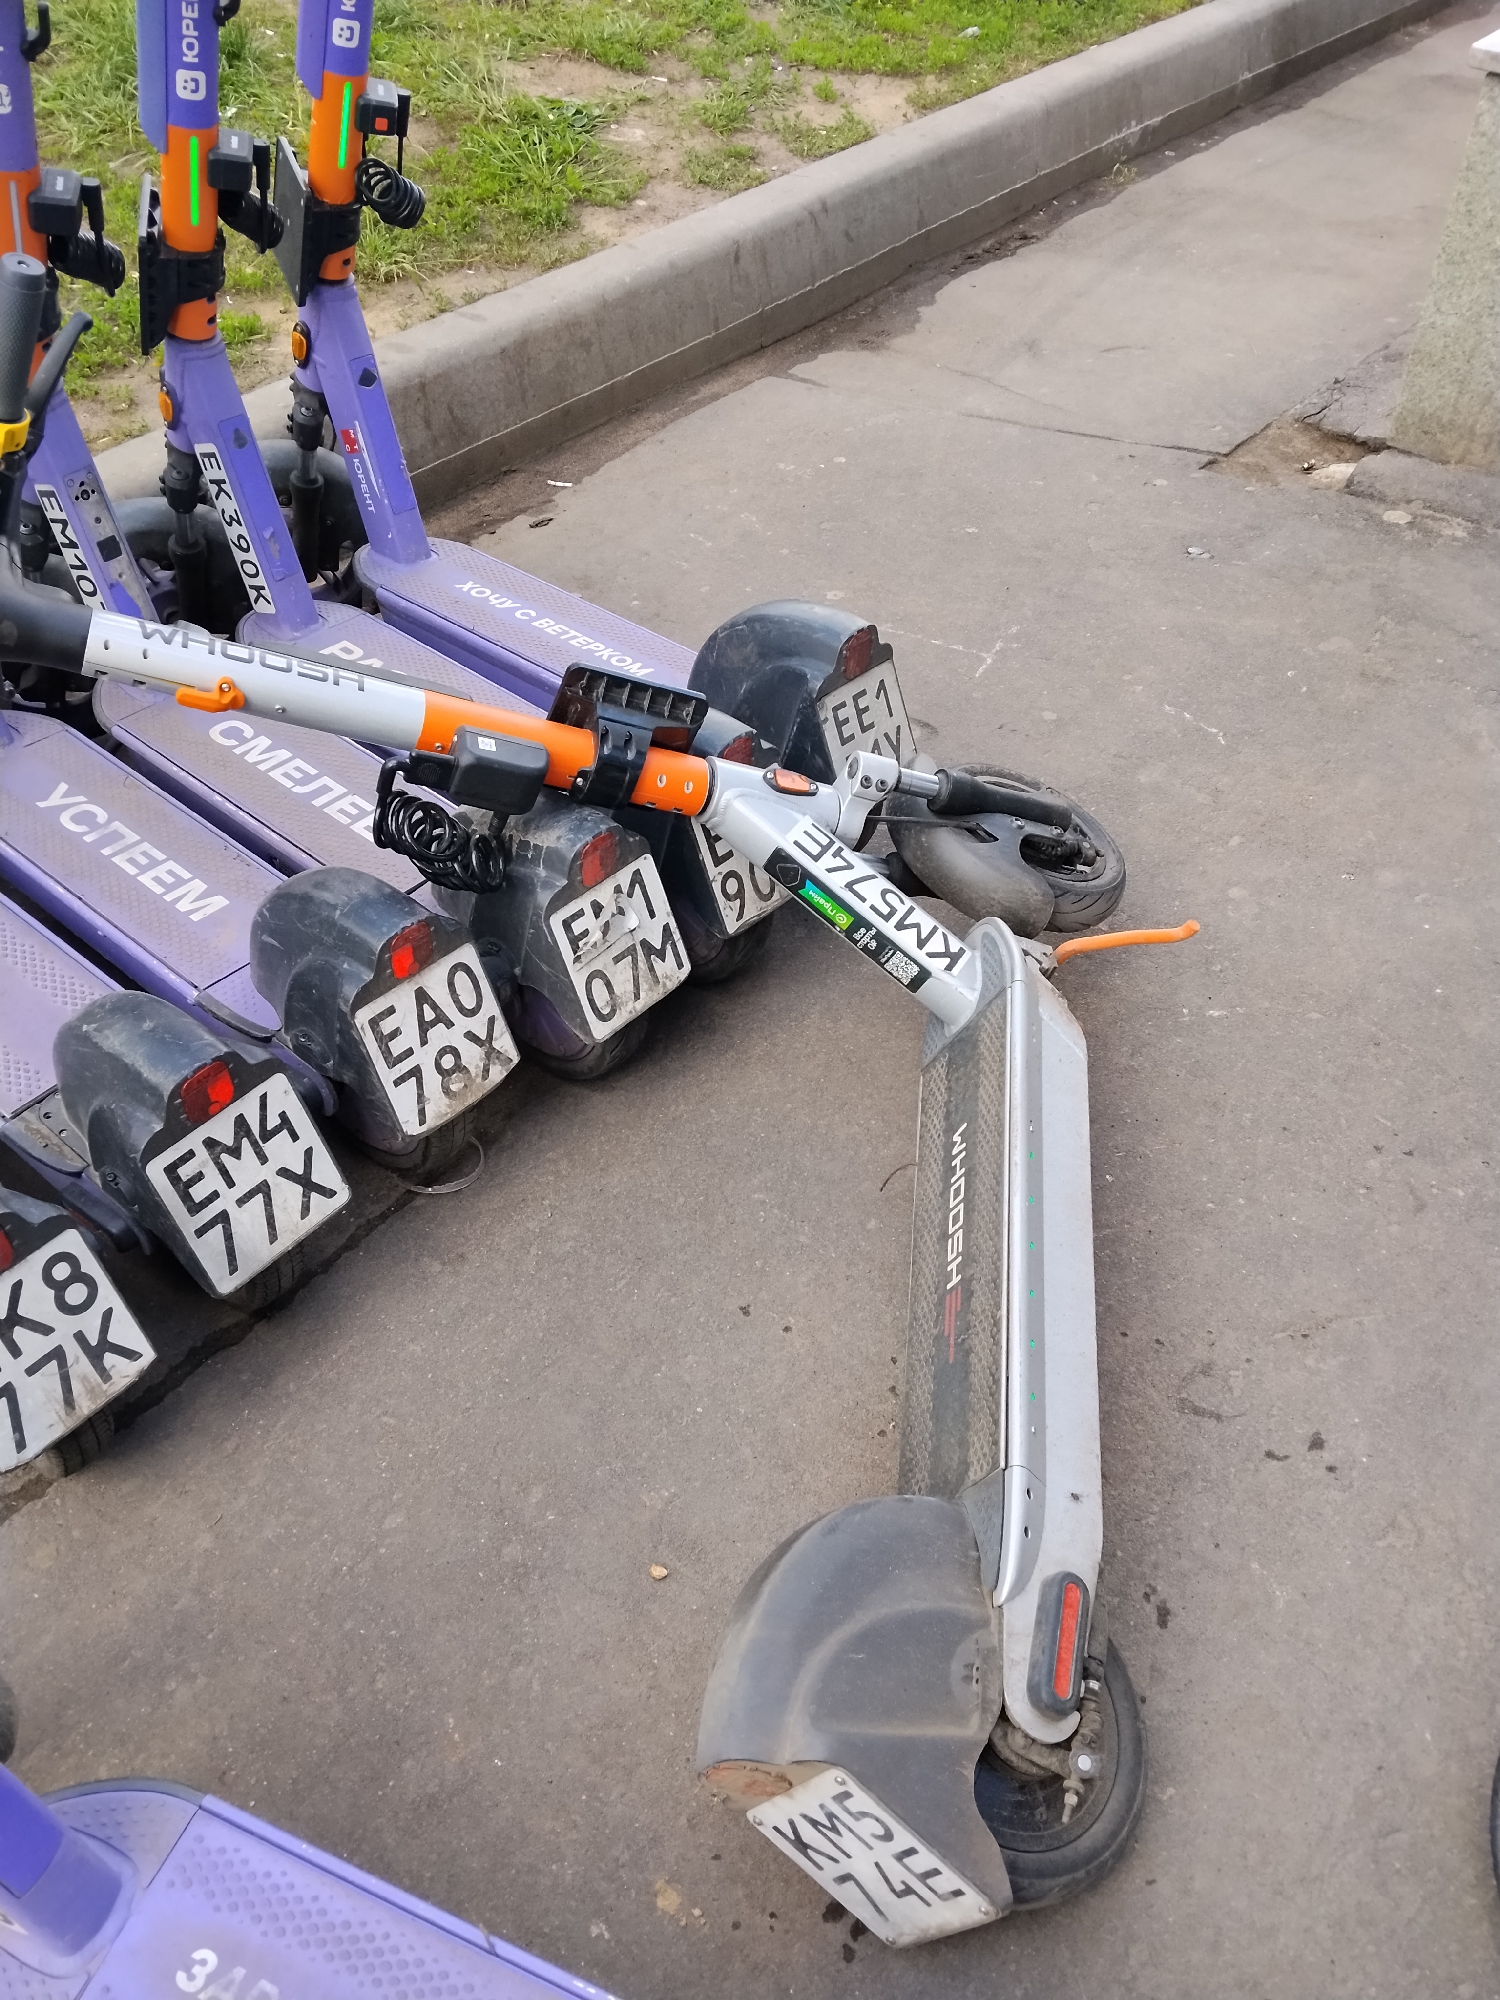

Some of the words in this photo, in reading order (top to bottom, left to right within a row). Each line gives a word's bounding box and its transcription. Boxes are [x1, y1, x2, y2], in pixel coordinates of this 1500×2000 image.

[199, 450, 272, 609] ЕК390К
[353, 458, 376, 514] ЮРЕНТ
[37, 489, 106, 611] ЕМ10
[137, 619, 366, 692] WHOOSH
[454, 581, 521, 609] ХОЧУ
[514, 609, 537, 620] С
[530, 617, 655, 677] ВЕТЕРКОМ
[831, 678, 894, 747] ЕЕ1
[35, 782, 231, 923] УСПЕЕМ
[792, 822, 967, 974] КМ574Е
[808, 889, 837, 916] Прайм
[584, 921, 685, 1023] 07М
[852, 927, 867, 941] Все
[856, 926, 877, 949] старты
[367, 961, 484, 1070] ЕА0
[392, 1014, 514, 1127] 78Х
[163, 1091, 300, 1218] ЕМ4
[946, 1122, 967, 1291] WHOOSH
[193, 1145, 338, 1276] 77Х
[0, 1250, 99, 1362] К8
[772, 1790, 895, 1872] КМ5
[833, 1846, 966, 1923] 74Е
